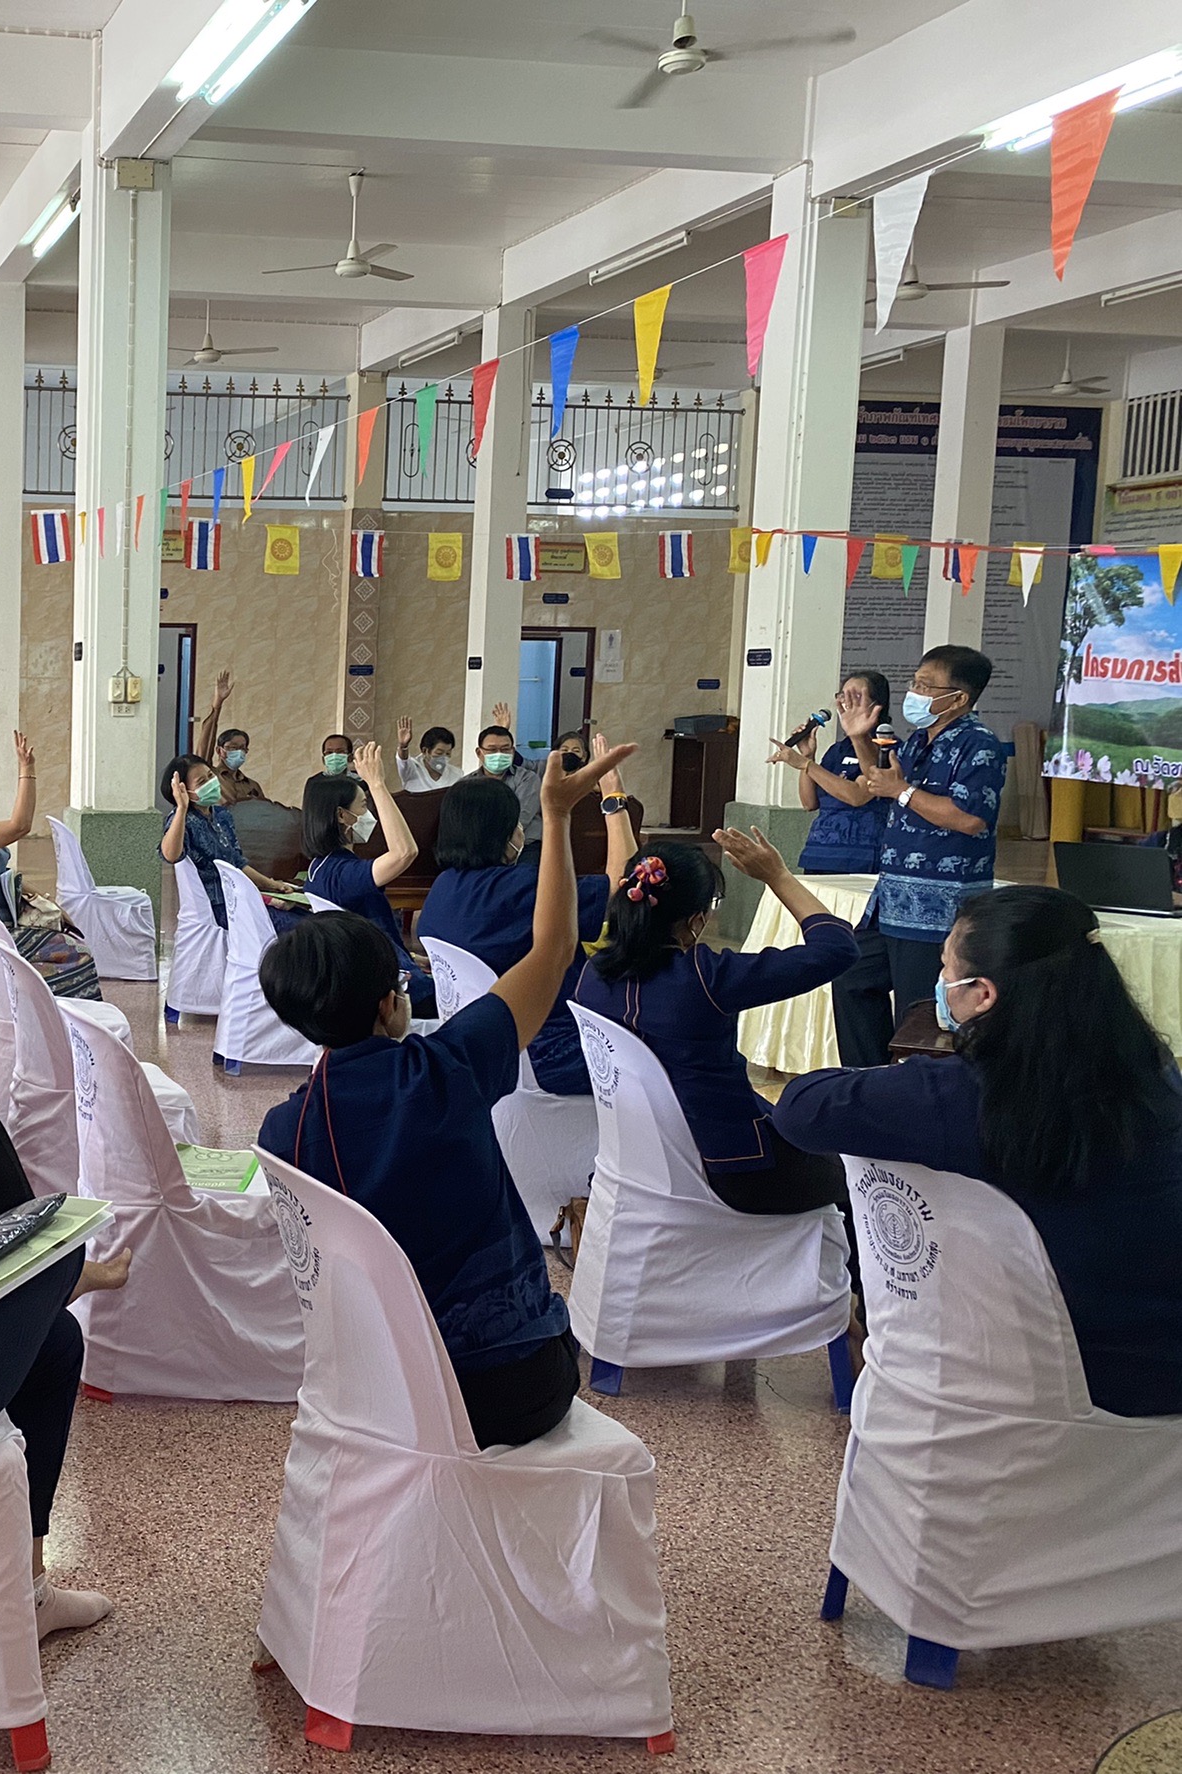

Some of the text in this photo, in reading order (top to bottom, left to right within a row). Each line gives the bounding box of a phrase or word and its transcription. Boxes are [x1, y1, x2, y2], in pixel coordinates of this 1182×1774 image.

[1083, 644, 1182, 683] โครงการส่
[1135, 757, 1182, 775] ณ วัดช
